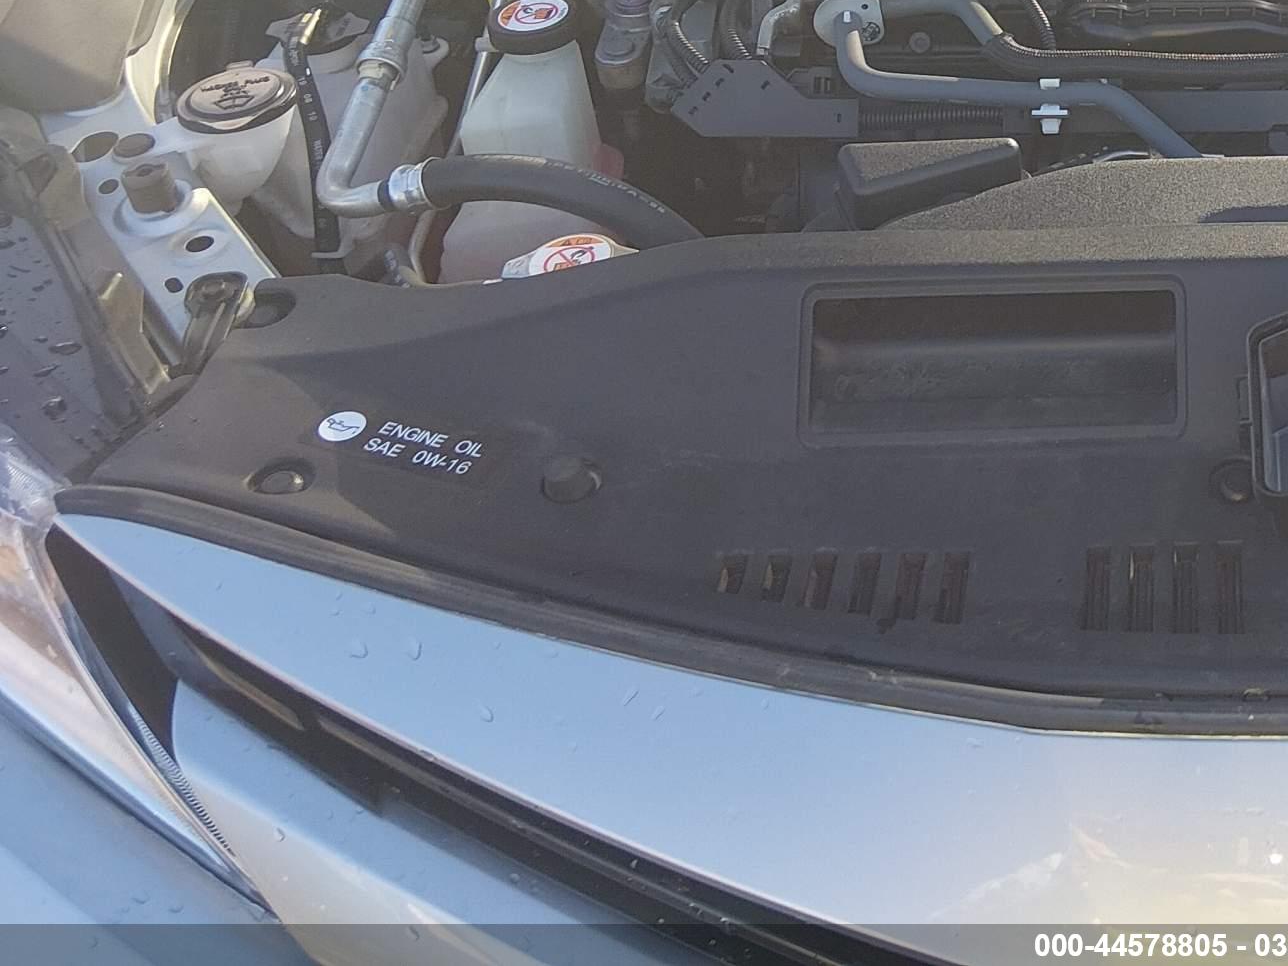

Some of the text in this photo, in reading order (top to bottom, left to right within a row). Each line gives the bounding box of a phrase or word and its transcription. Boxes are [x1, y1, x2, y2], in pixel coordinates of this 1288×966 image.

[363, 438, 473, 475] SAE 0W-16
[378, 421, 483, 458] ENGINE OIL
